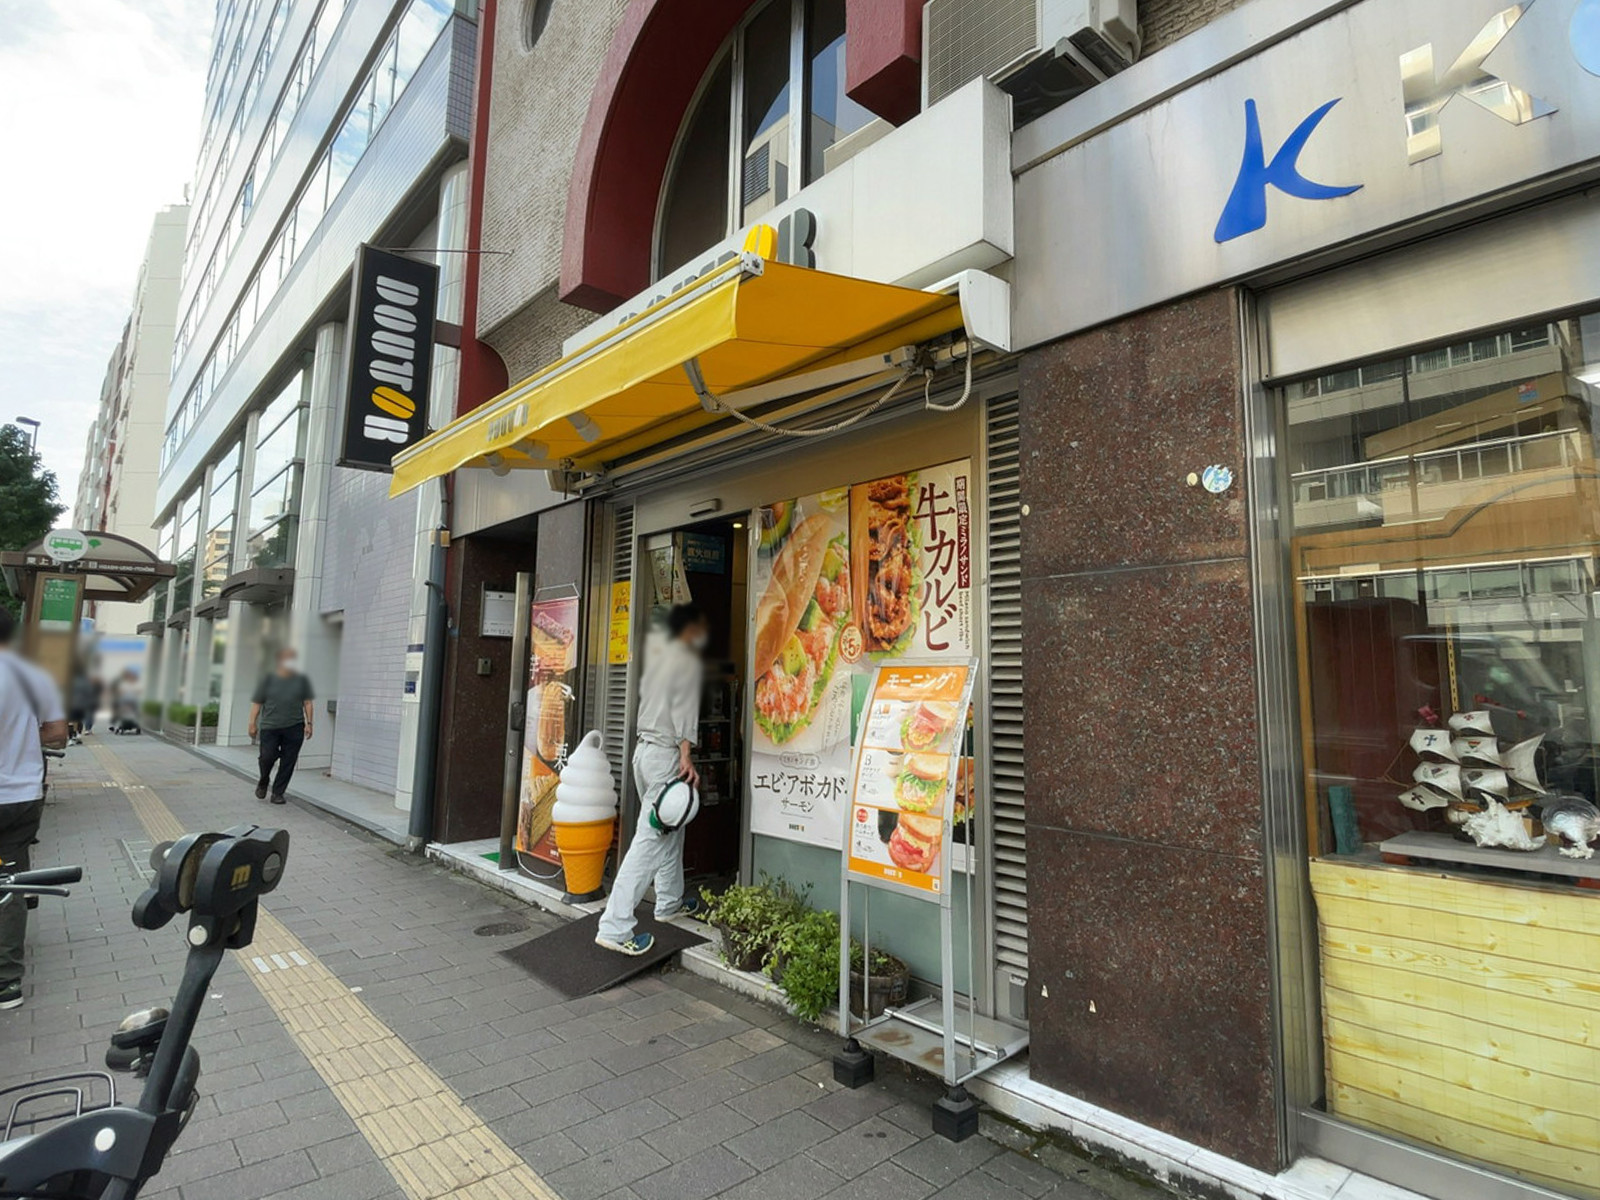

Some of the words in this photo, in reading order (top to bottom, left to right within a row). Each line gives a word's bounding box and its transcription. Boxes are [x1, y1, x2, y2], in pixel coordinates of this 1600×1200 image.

[363, 275, 420, 444] DOUTOR
[913, 483, 957, 651] 牛カルビ
[887, 672, 957, 691] モーニング
[781, 797, 814, 813] サーモン
